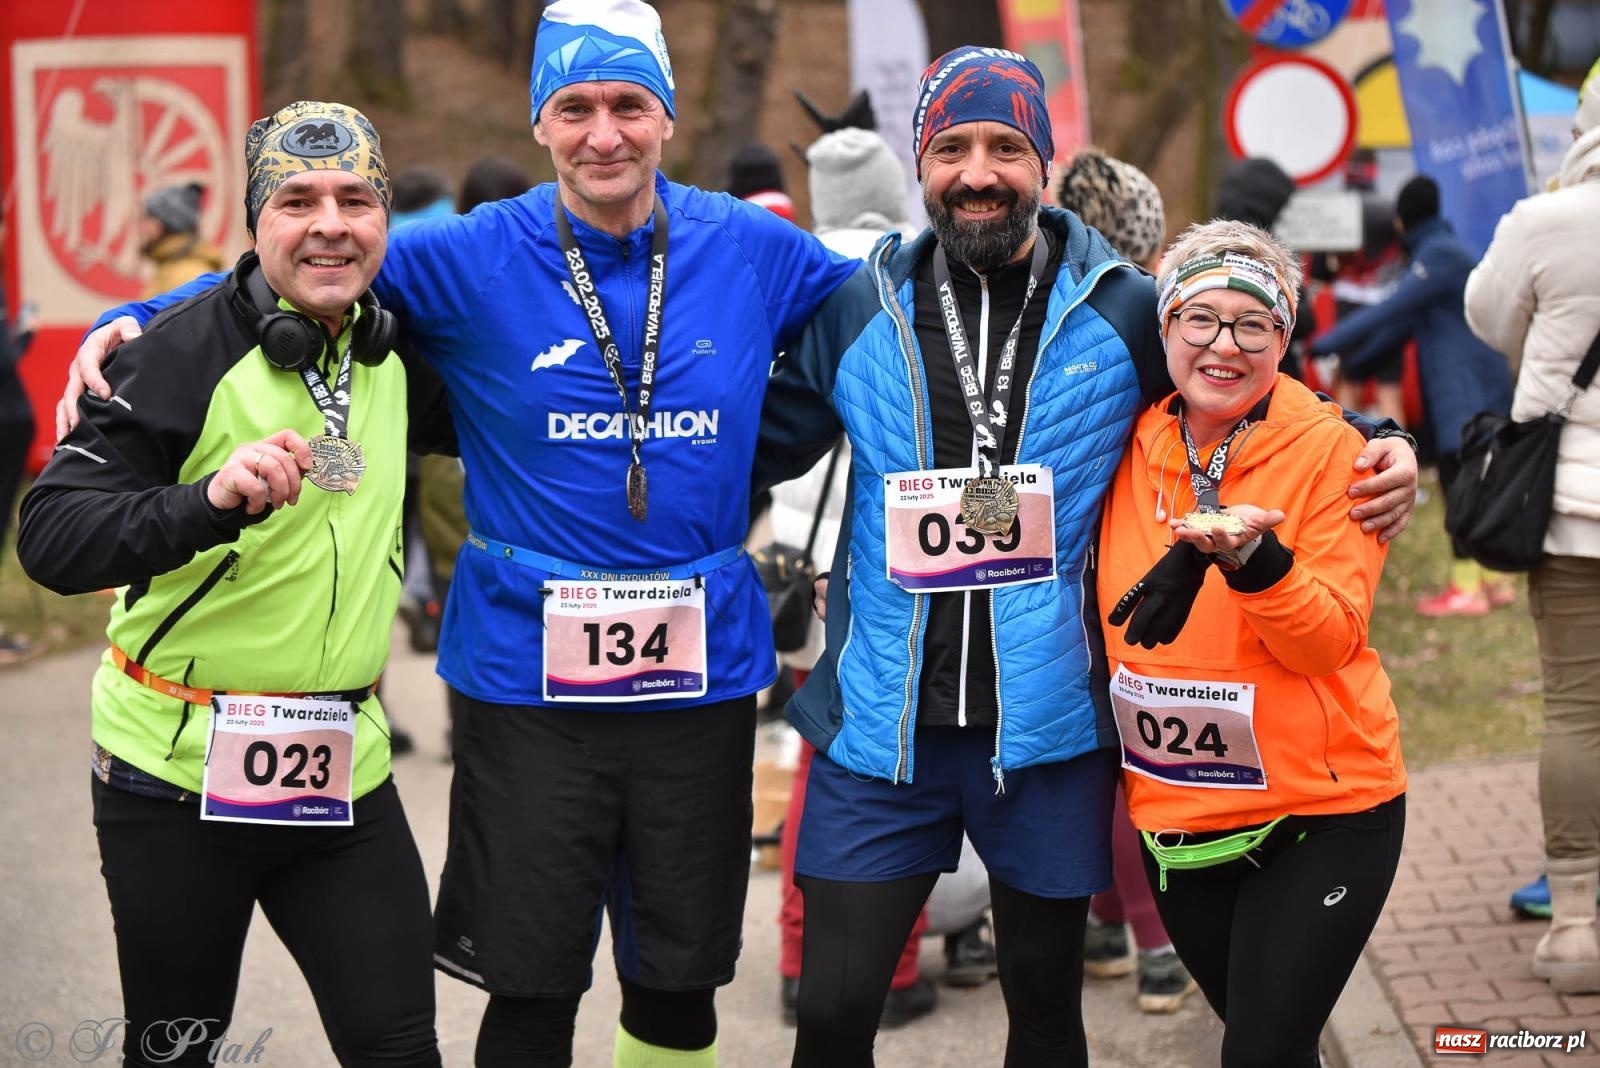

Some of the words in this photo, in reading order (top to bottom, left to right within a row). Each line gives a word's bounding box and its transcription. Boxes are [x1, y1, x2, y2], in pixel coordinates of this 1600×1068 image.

[565, 247, 611, 340] 23.02.2025
[645, 253, 665, 346] TWARDZIELA
[940, 280, 967, 363] TWARDZIELA
[641, 351, 655, 385] BIEG
[961, 365, 979, 397] BIEG
[997, 375, 1009, 392] 13
[639, 390, 650, 406] 13
[970, 401, 984, 417] 13
[899, 478, 934, 492] BIEG
[581, 570, 599, 579] XXX
[601, 572, 618, 581] DNI
[988, 567, 1026, 577] Racibórz
[560, 587, 597, 600] BIEG
[602, 586, 692, 600] Twardziela
[583, 622, 669, 666] 134
[642, 679, 675, 688] Racibórz
[1118, 672, 1143, 690] BIEG
[1146, 682, 1239, 702] Twardziela
[227, 703, 266, 716] BIEG
[272, 705, 348, 722] Twardziela
[1137, 710, 1229, 757] 024
[243, 741, 331, 789] 023
[1198, 770, 1235, 778] Racibórz
[302, 806, 329, 815] Racibórz
